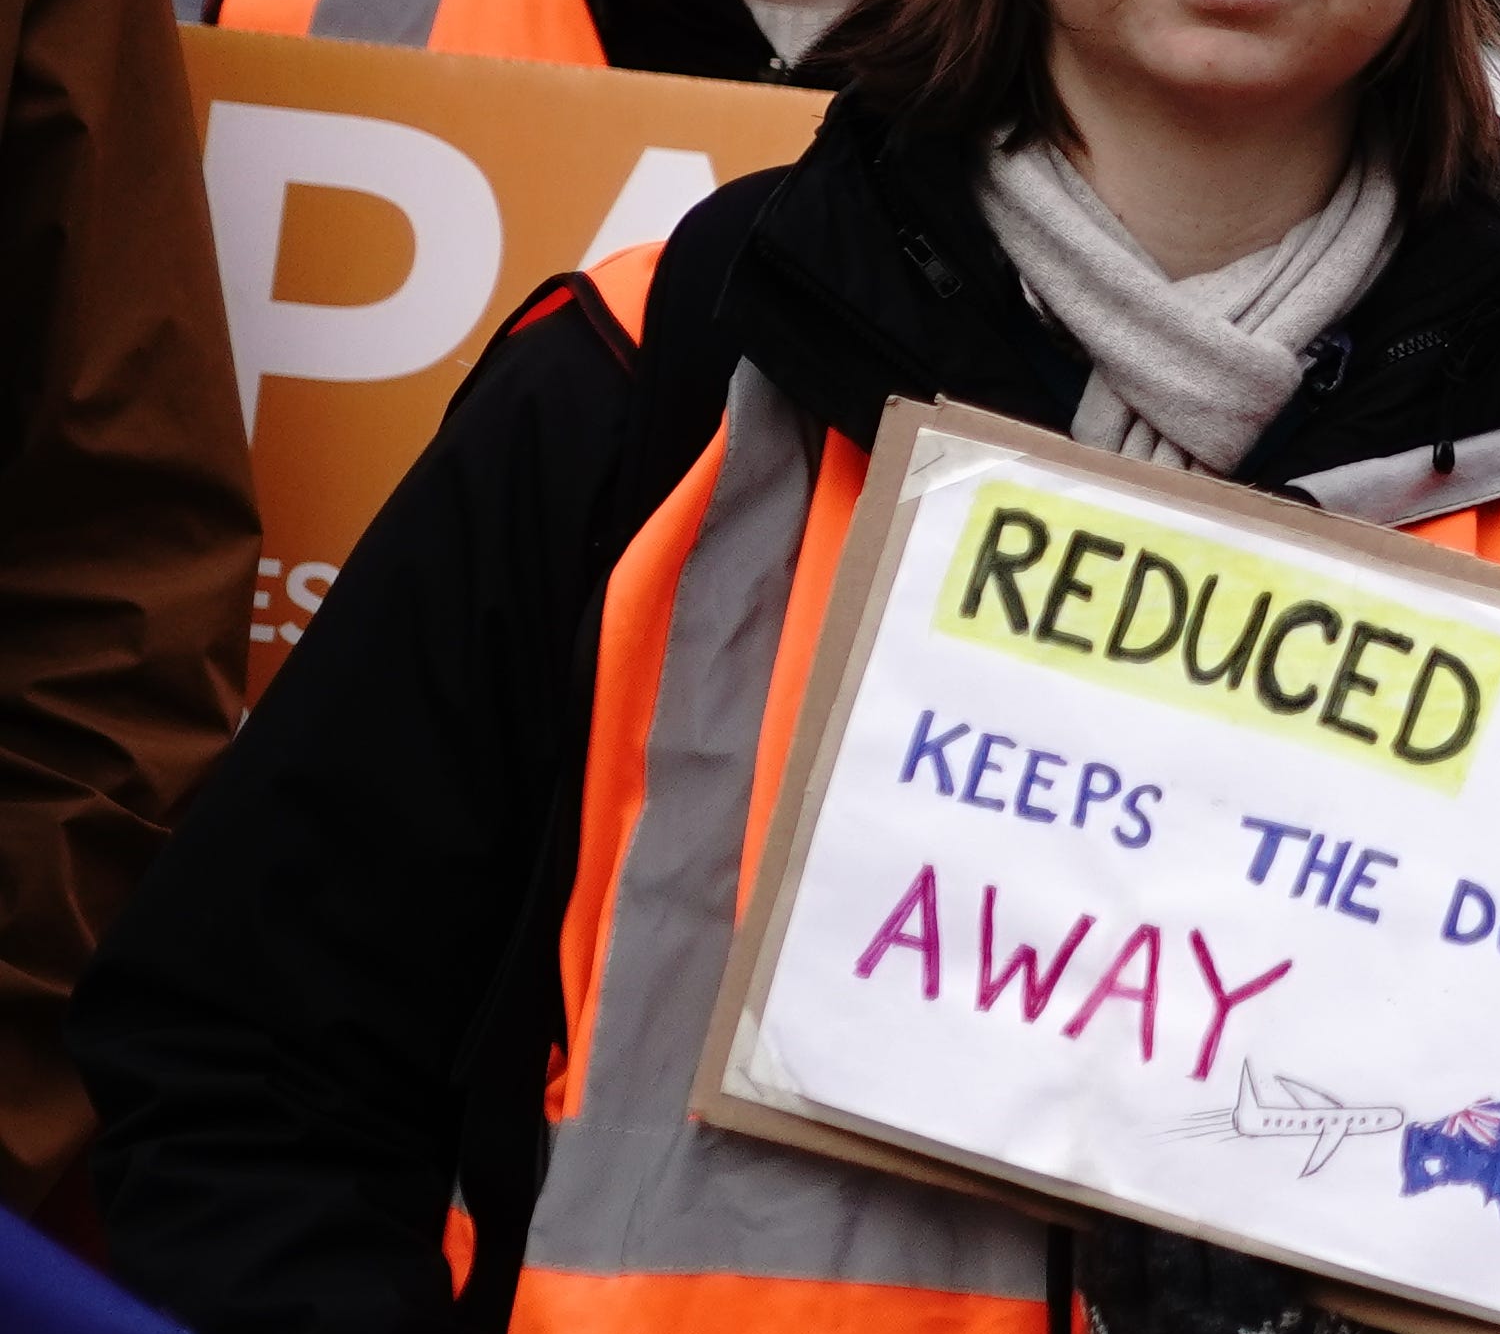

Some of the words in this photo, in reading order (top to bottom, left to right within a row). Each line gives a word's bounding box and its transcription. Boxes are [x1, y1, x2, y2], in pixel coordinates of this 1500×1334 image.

[958, 506, 1482, 764] REDUCED
[899, 708, 1165, 849] KEEPS
[1242, 814, 1399, 925] THE
[853, 863, 1295, 1083] AWAY
